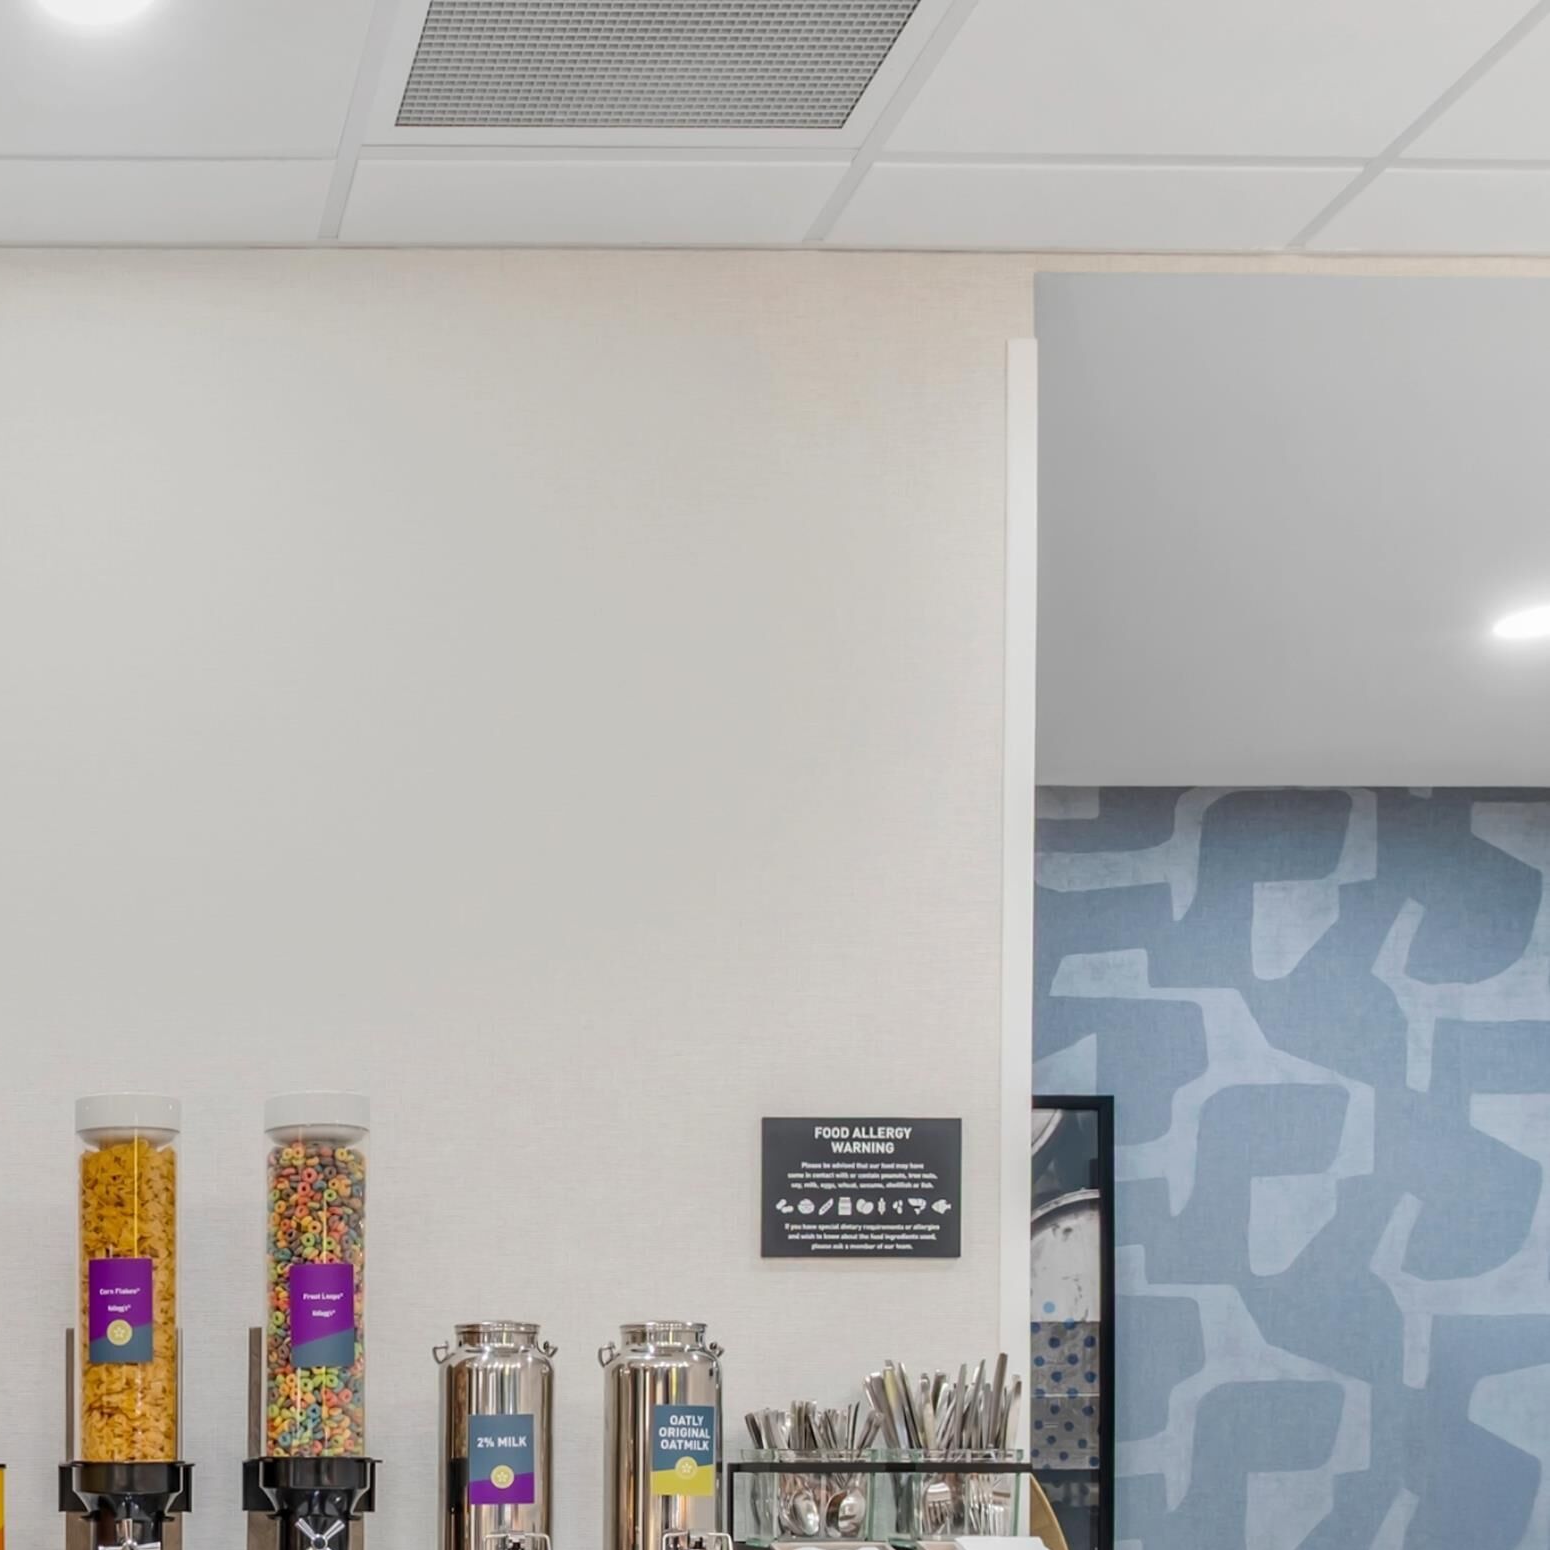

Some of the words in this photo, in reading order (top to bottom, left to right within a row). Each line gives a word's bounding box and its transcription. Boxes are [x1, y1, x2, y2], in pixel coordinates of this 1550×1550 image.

[814, 1126, 850, 1140] FOOD
[852, 1126, 913, 1140] ALLERGY
[831, 1141, 895, 1154] WARNING
[669, 1415, 705, 1427] OATLY
[658, 1427, 711, 1439] ORIGINAL
[476, 1436, 495, 1448] 2%
[497, 1436, 527, 1448] MILK
[660, 1438, 709, 1451] OATMILK
